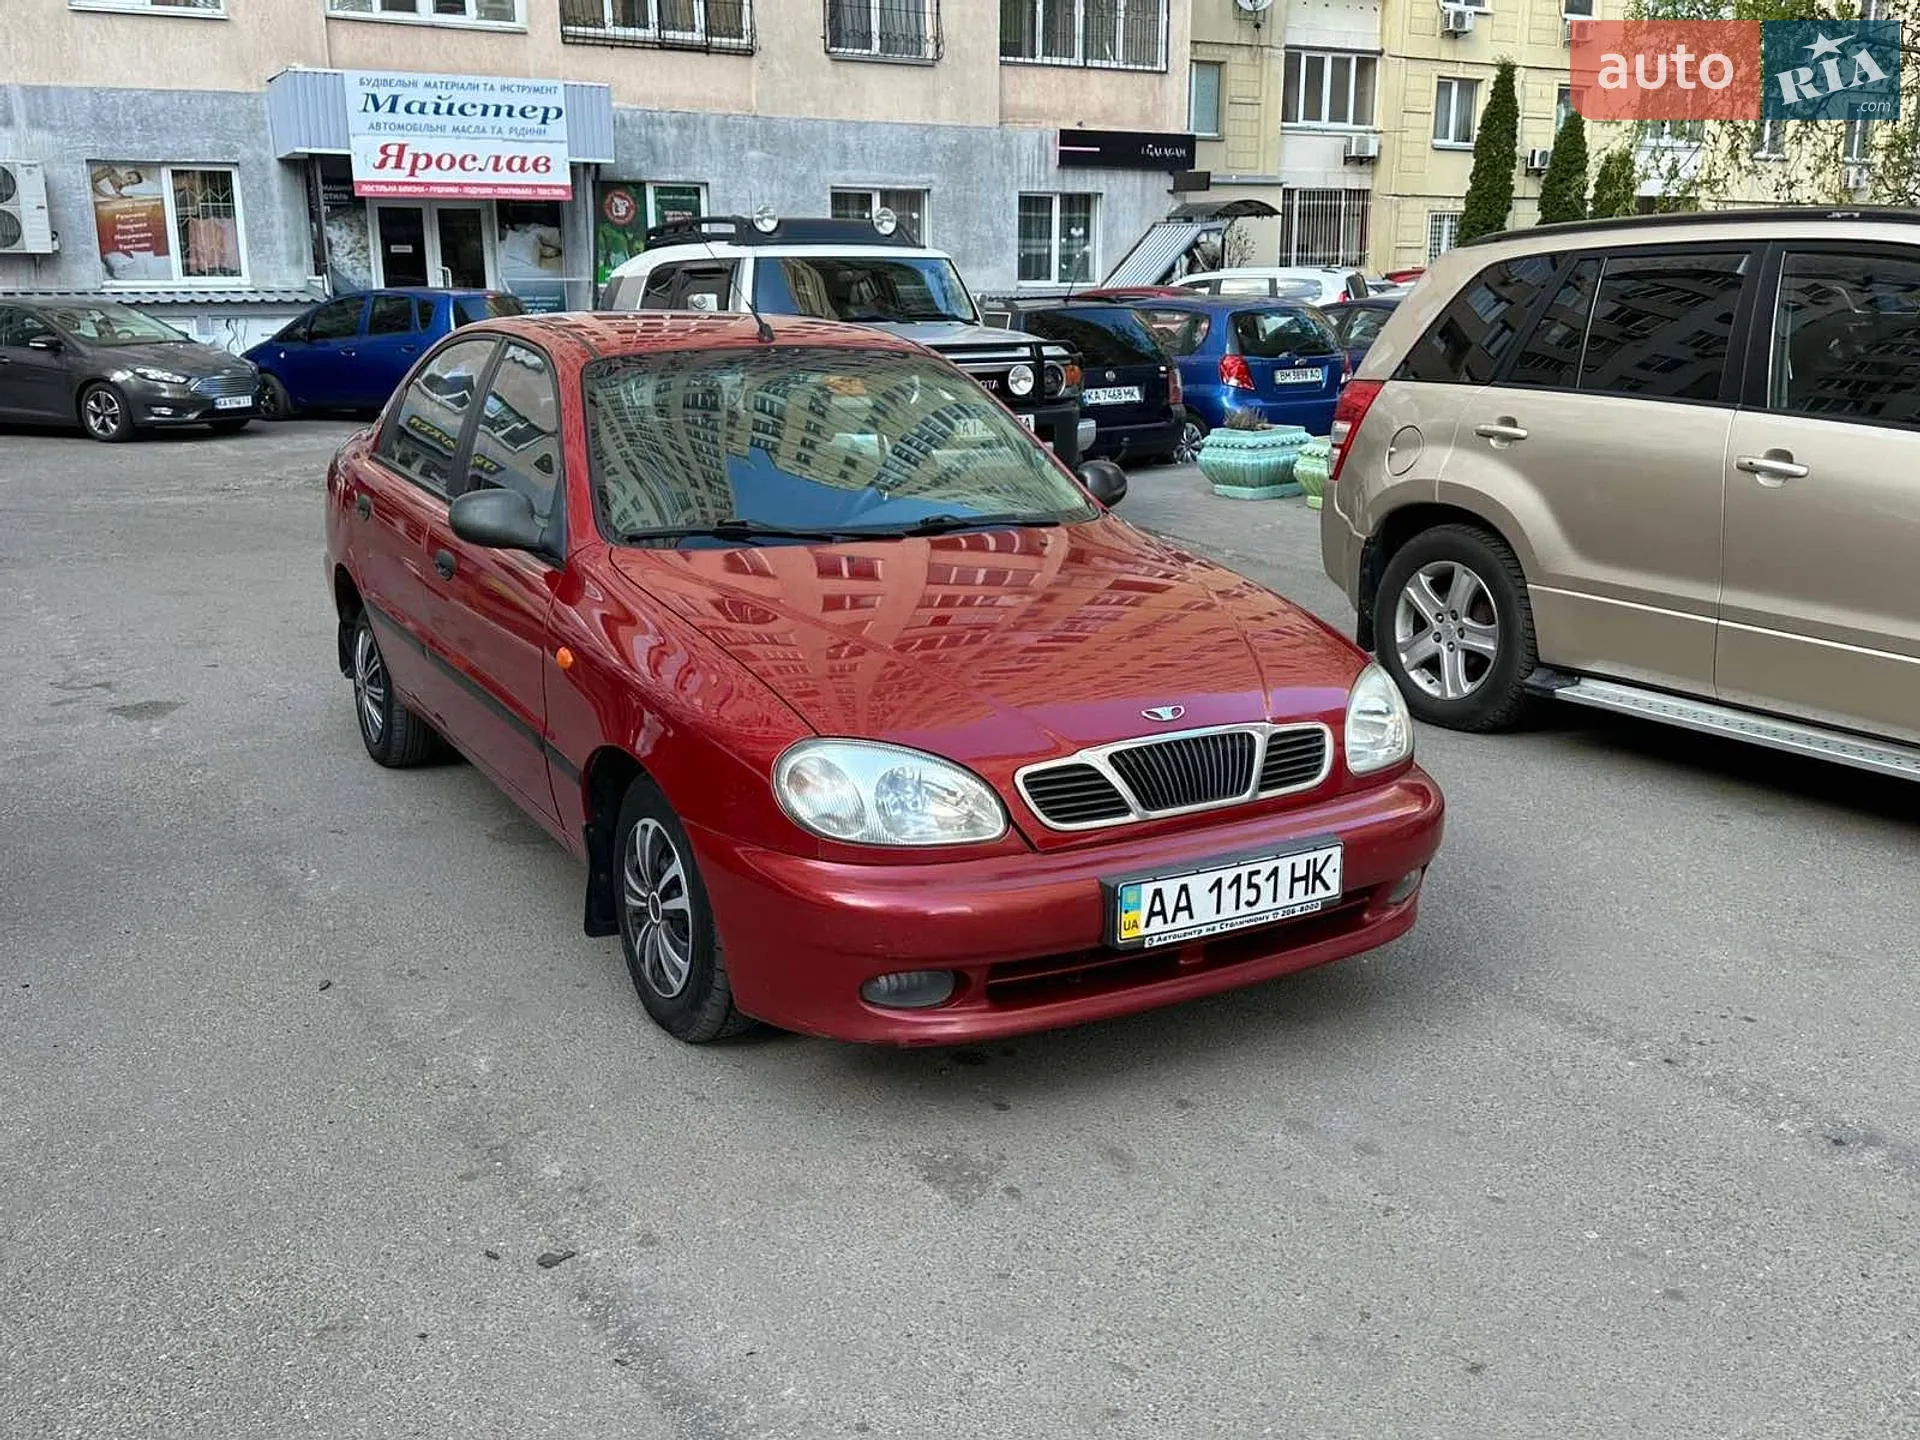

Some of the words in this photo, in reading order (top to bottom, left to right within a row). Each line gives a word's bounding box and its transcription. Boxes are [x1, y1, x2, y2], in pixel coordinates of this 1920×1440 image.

[358, 77, 418, 89] БУДІВЕЛЬНІ
[423, 80, 479, 91] МАТЕРІАЛИ
[482, 82, 495, 92] ТА
[500, 83, 558, 95] ІНСТРУМЕНТ
[360, 92, 564, 125] Майстер
[368, 122, 447, 133] АВТОМОБІЛЬНІ
[452, 125, 487, 134] МАСЛА
[491, 126, 504, 135] ТА
[509, 127, 547, 137] РІДИНИ
[373, 142, 551, 177] Ярослав
[980, 379, 1000, 390] OTA
[1144, 883, 1195, 929] AA
[1208, 865, 1279, 914] 1151
[1288, 853, 1333, 899] HK
[1123, 918, 1139, 932] UA
[1156, 928, 1203, 943] Автоцентр
